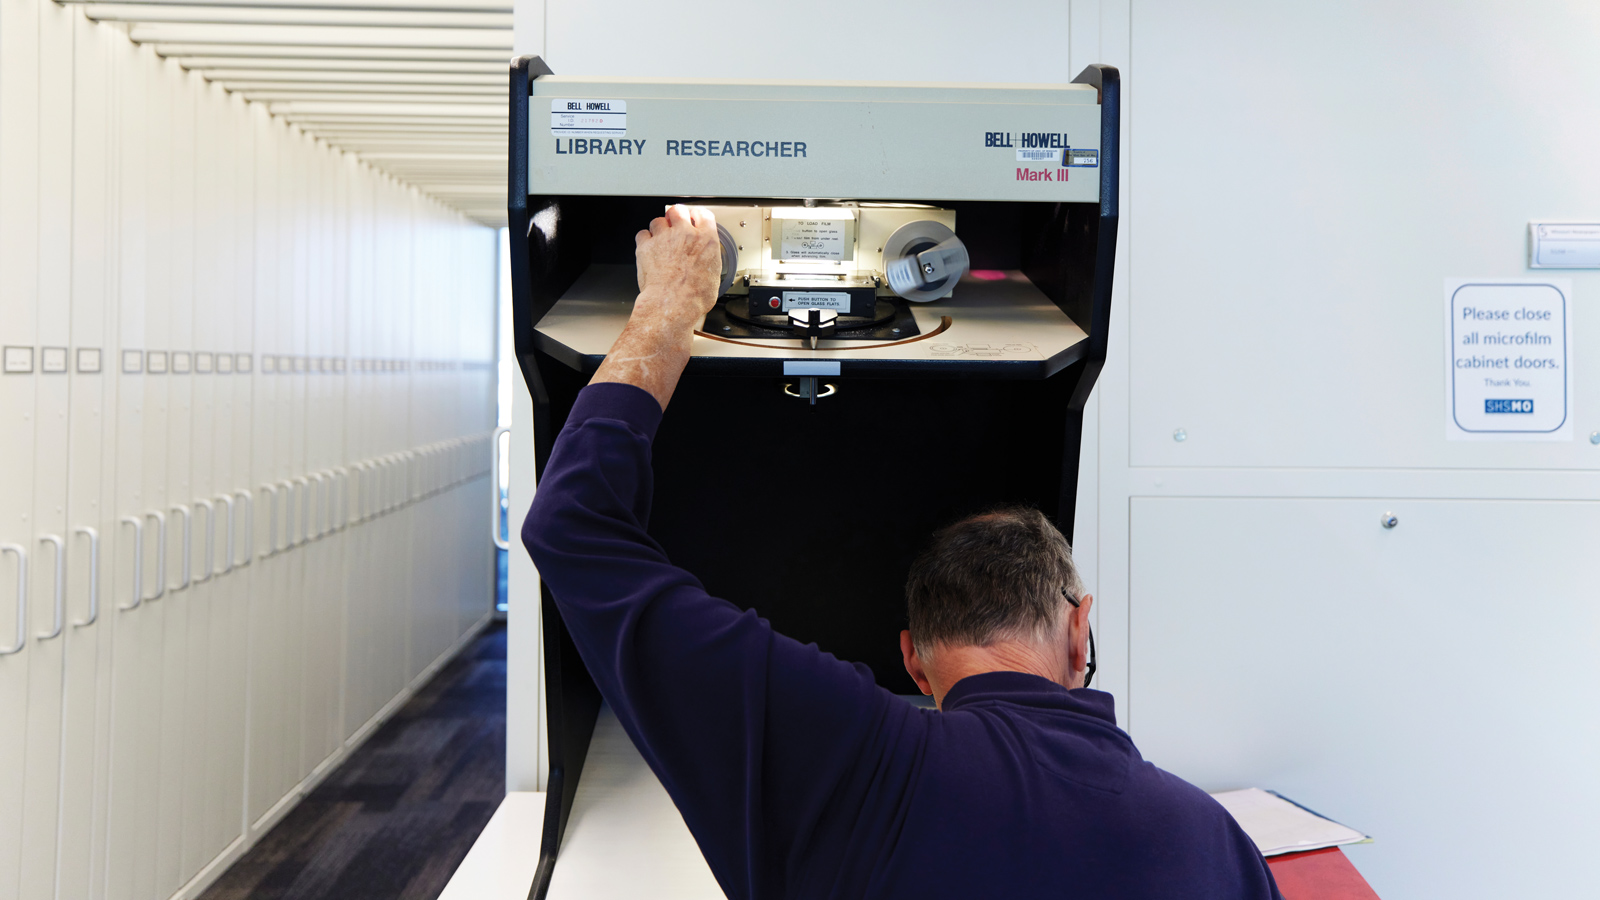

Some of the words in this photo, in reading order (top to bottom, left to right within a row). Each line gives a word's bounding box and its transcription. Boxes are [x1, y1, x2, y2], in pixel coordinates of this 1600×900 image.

[567, 102, 582, 110] BELL
[586, 102, 611, 110] HOWELL
[556, 138, 646, 155] LIBRARY
[666, 139, 808, 158] RESEARCHER
[1016, 168, 1053, 182] Mark
[1056, 168, 1069, 182] III
[1462, 306, 1510, 320] Please
[1514, 306, 1552, 320] close
[1462, 331, 1479, 345] all
[1483, 331, 1552, 345] microfilm
[1456, 355, 1510, 369] cabinet
[1514, 355, 1560, 369] doors.
[1484, 378, 1510, 387] Thank
[1486, 400, 1532, 412] SHSMO
